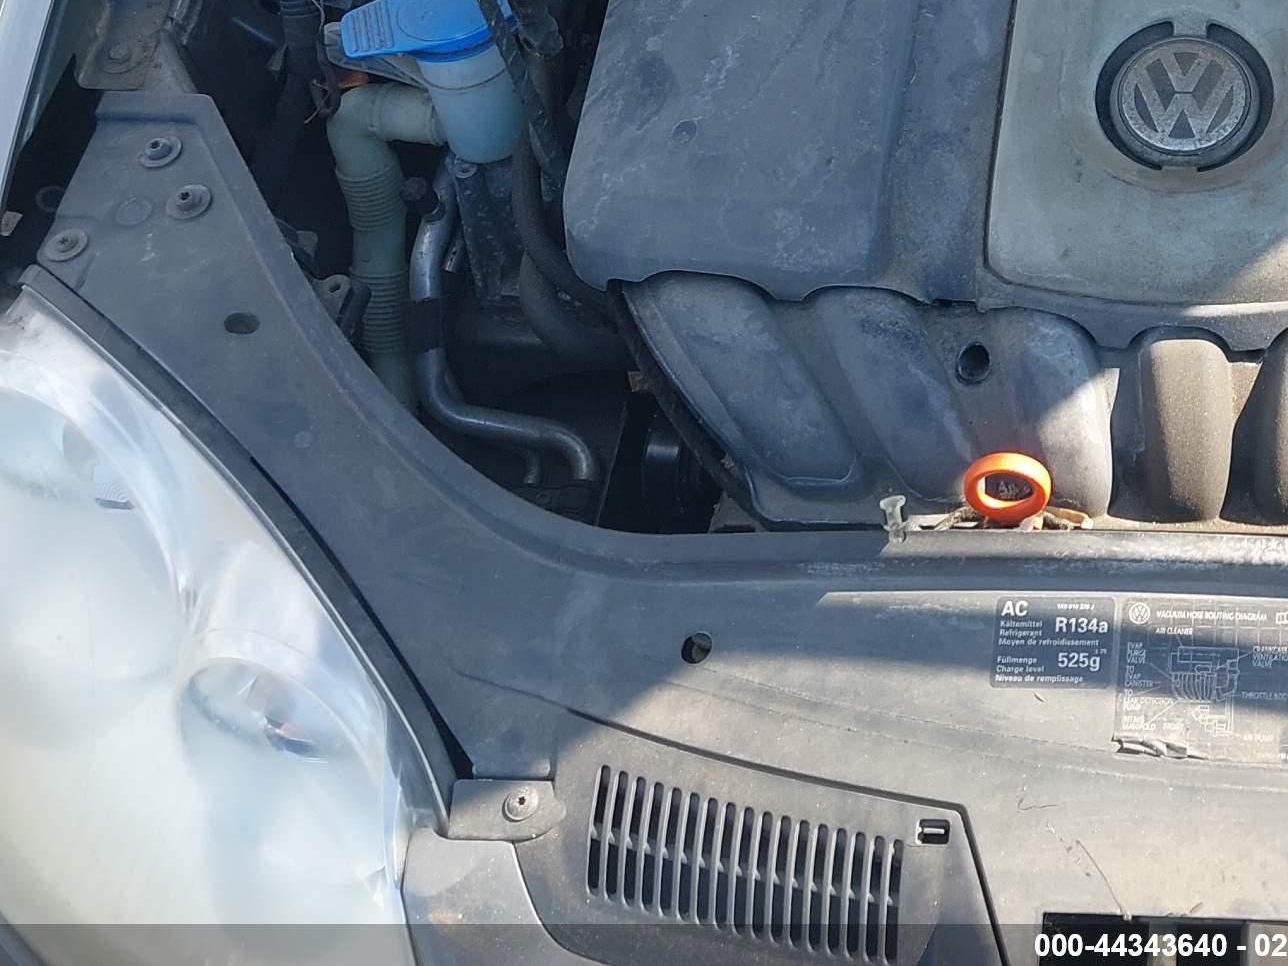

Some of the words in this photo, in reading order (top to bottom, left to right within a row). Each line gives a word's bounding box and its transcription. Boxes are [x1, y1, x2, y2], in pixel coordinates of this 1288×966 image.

[1001, 600, 1029, 616] AC
[1156, 610, 1186, 619] VACUUM
[1186, 610, 1204, 620] HOSE
[1204, 610, 1234, 620] ROUTING
[1236, 612, 1267, 622] DIAGRAM
[1000, 620, 1043, 628] Kältemittel
[1055, 616, 1109, 634] R134a
[999, 628, 1042, 638] Refrigerant
[1166, 627, 1194, 636] CLEANER
[998, 638, 1025, 647] Moyen
[1026, 638, 1037, 646] de
[1038, 638, 1100, 646] refroidissement
[996, 655, 1038, 664] Füllmenge
[1057, 652, 1101, 672] 525g
[996, 664, 1024, 674] Charge
[994, 674, 1022, 682] Niveau
[1024, 674, 1035, 682] de
[1036, 674, 1084, 684] remplissage
[1242, 691, 1272, 700] THROTTLE
